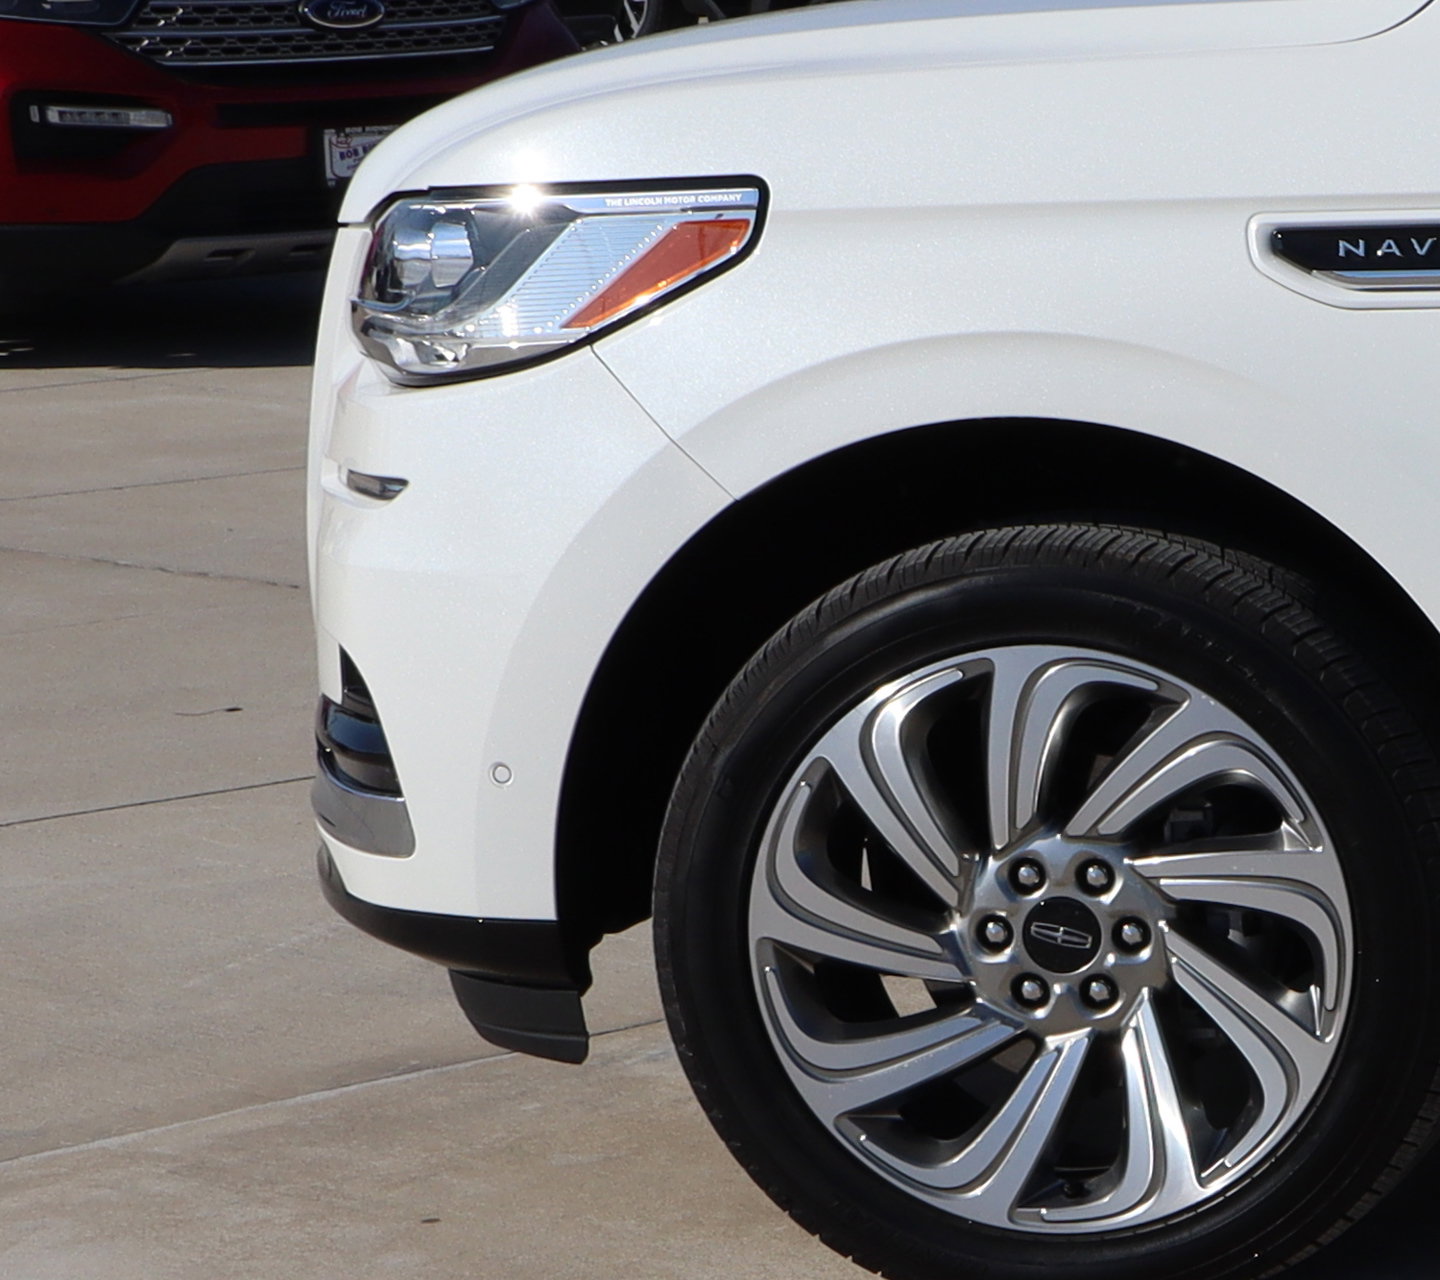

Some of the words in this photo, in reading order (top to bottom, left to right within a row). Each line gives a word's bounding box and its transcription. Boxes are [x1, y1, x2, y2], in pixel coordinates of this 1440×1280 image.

[327, 1, 367, 18] Ford
[605, 198, 623, 207] THE
[624, 196, 663, 206] LINCOLN
[664, 195, 696, 205] MOTOR
[697, 193, 743, 203] COMPANY
